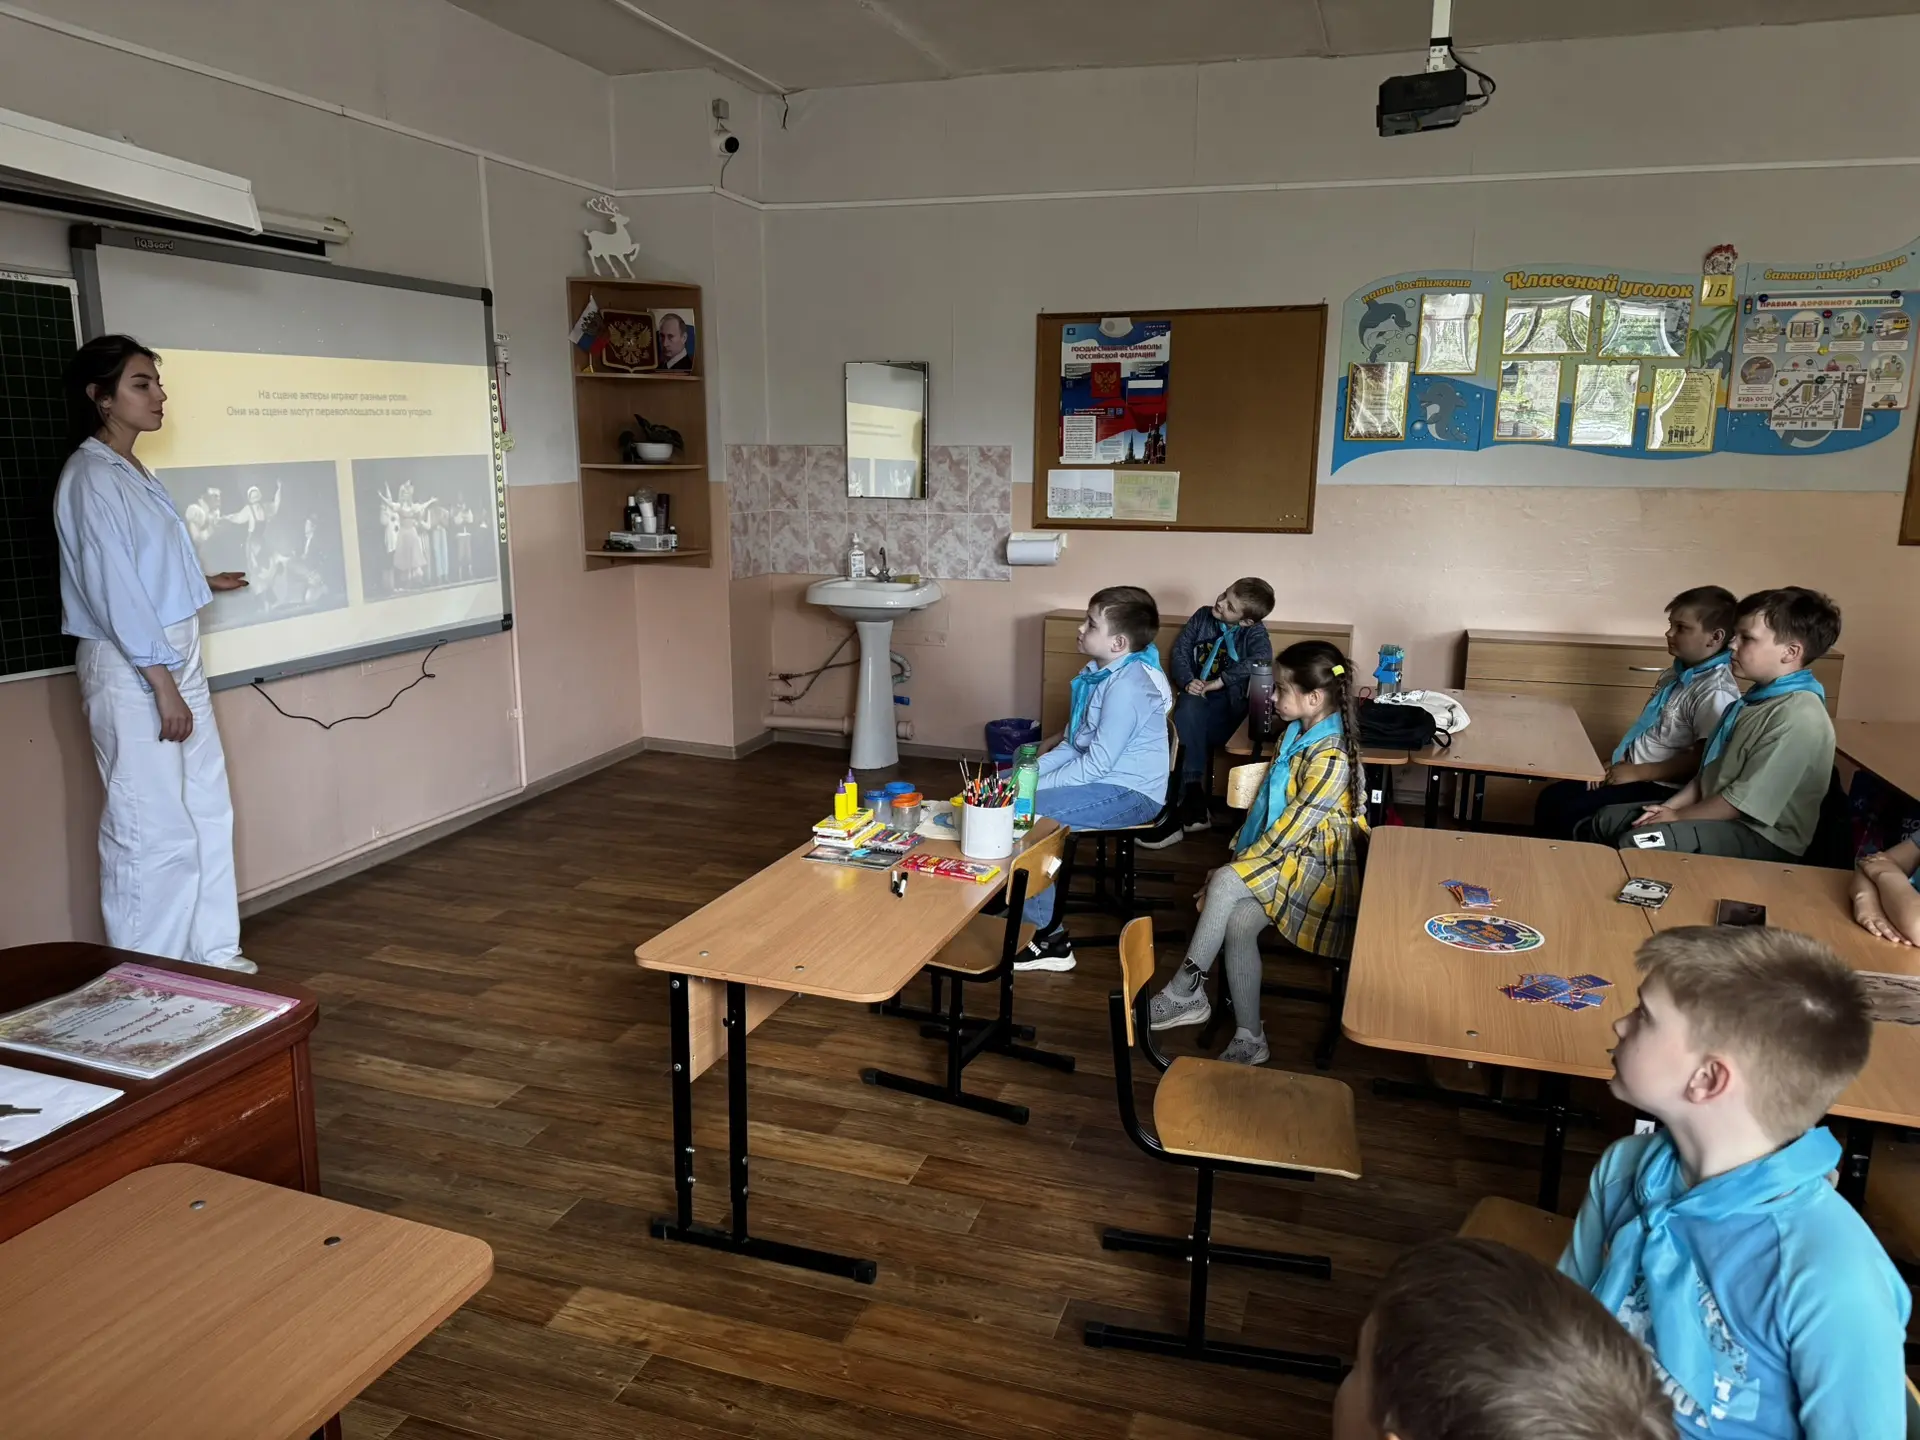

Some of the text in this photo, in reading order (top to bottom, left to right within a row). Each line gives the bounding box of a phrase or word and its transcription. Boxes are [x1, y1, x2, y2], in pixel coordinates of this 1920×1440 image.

[1763, 255, 1908, 281] важная информация
[1361, 277, 1471, 304] наши достижения
[1503, 271, 1694, 299] Классный уголок
[1800, 299, 1853, 308] ДОРОЖНОГО
[1076, 351, 1156, 360] РОССИЙСКОЙ ФЕДЕРАЦИИ
